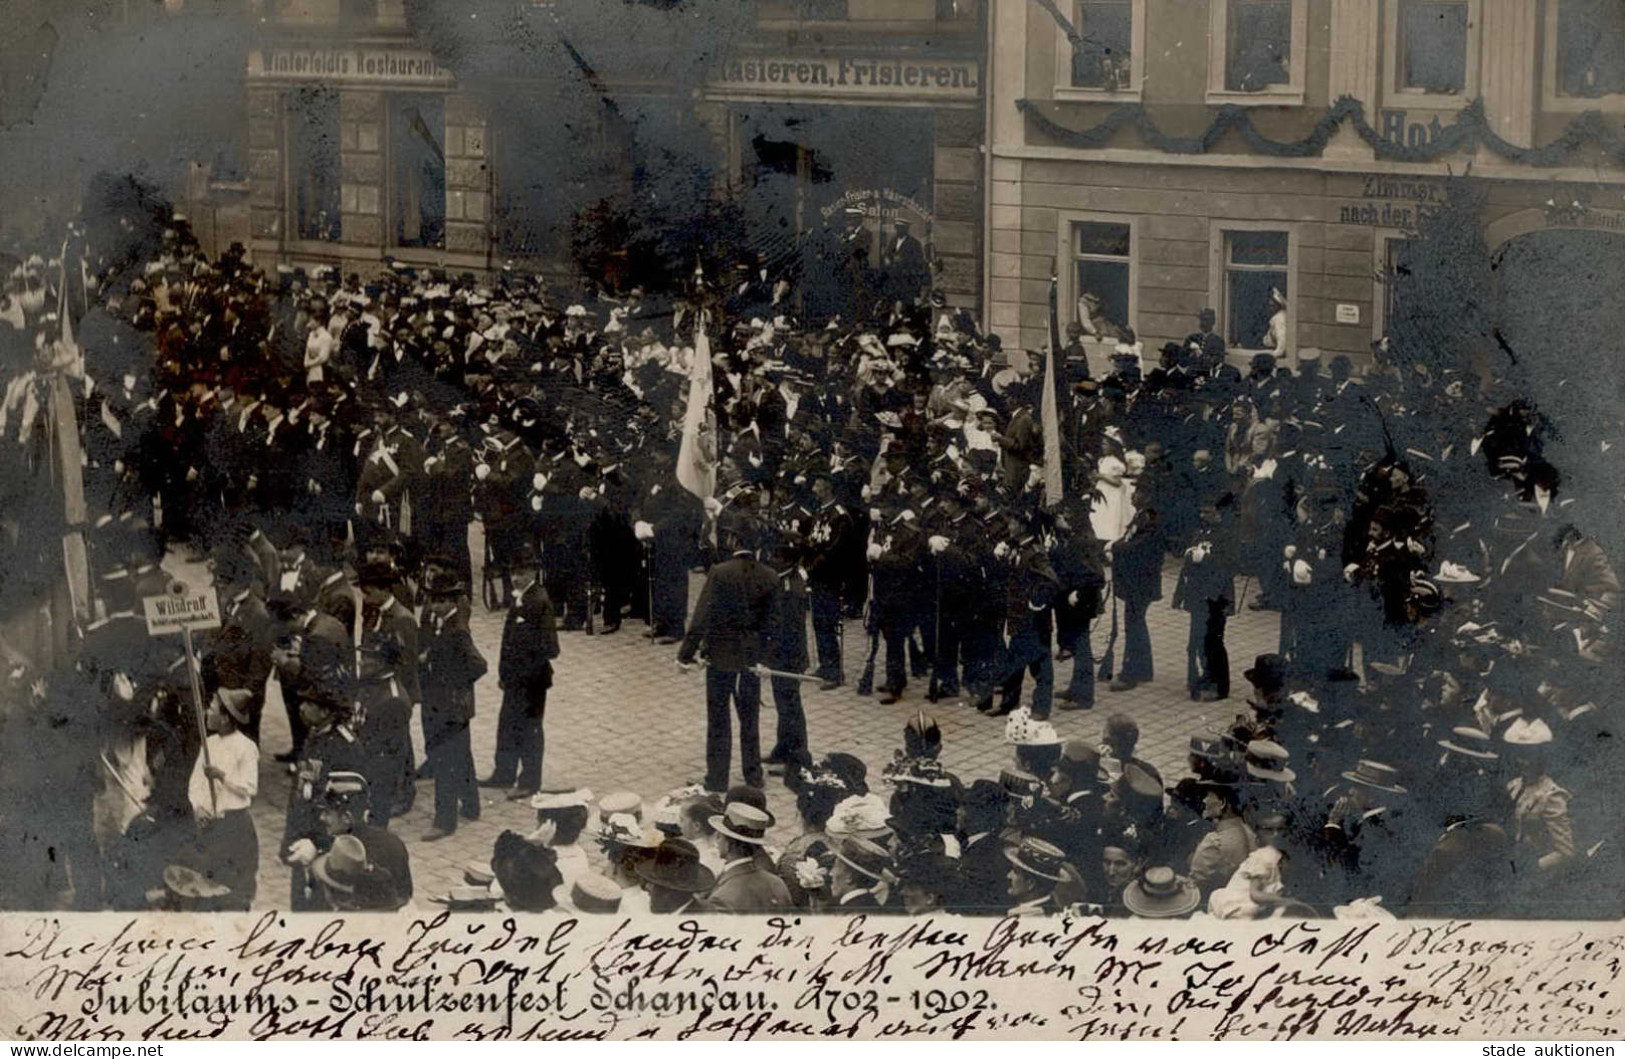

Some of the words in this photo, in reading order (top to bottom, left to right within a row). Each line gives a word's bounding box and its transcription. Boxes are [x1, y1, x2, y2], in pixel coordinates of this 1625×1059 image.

[837, 59, 978, 88] Frisieren.
[857, 202, 898, 217] Salon
[1340, 202, 1379, 224] nach
